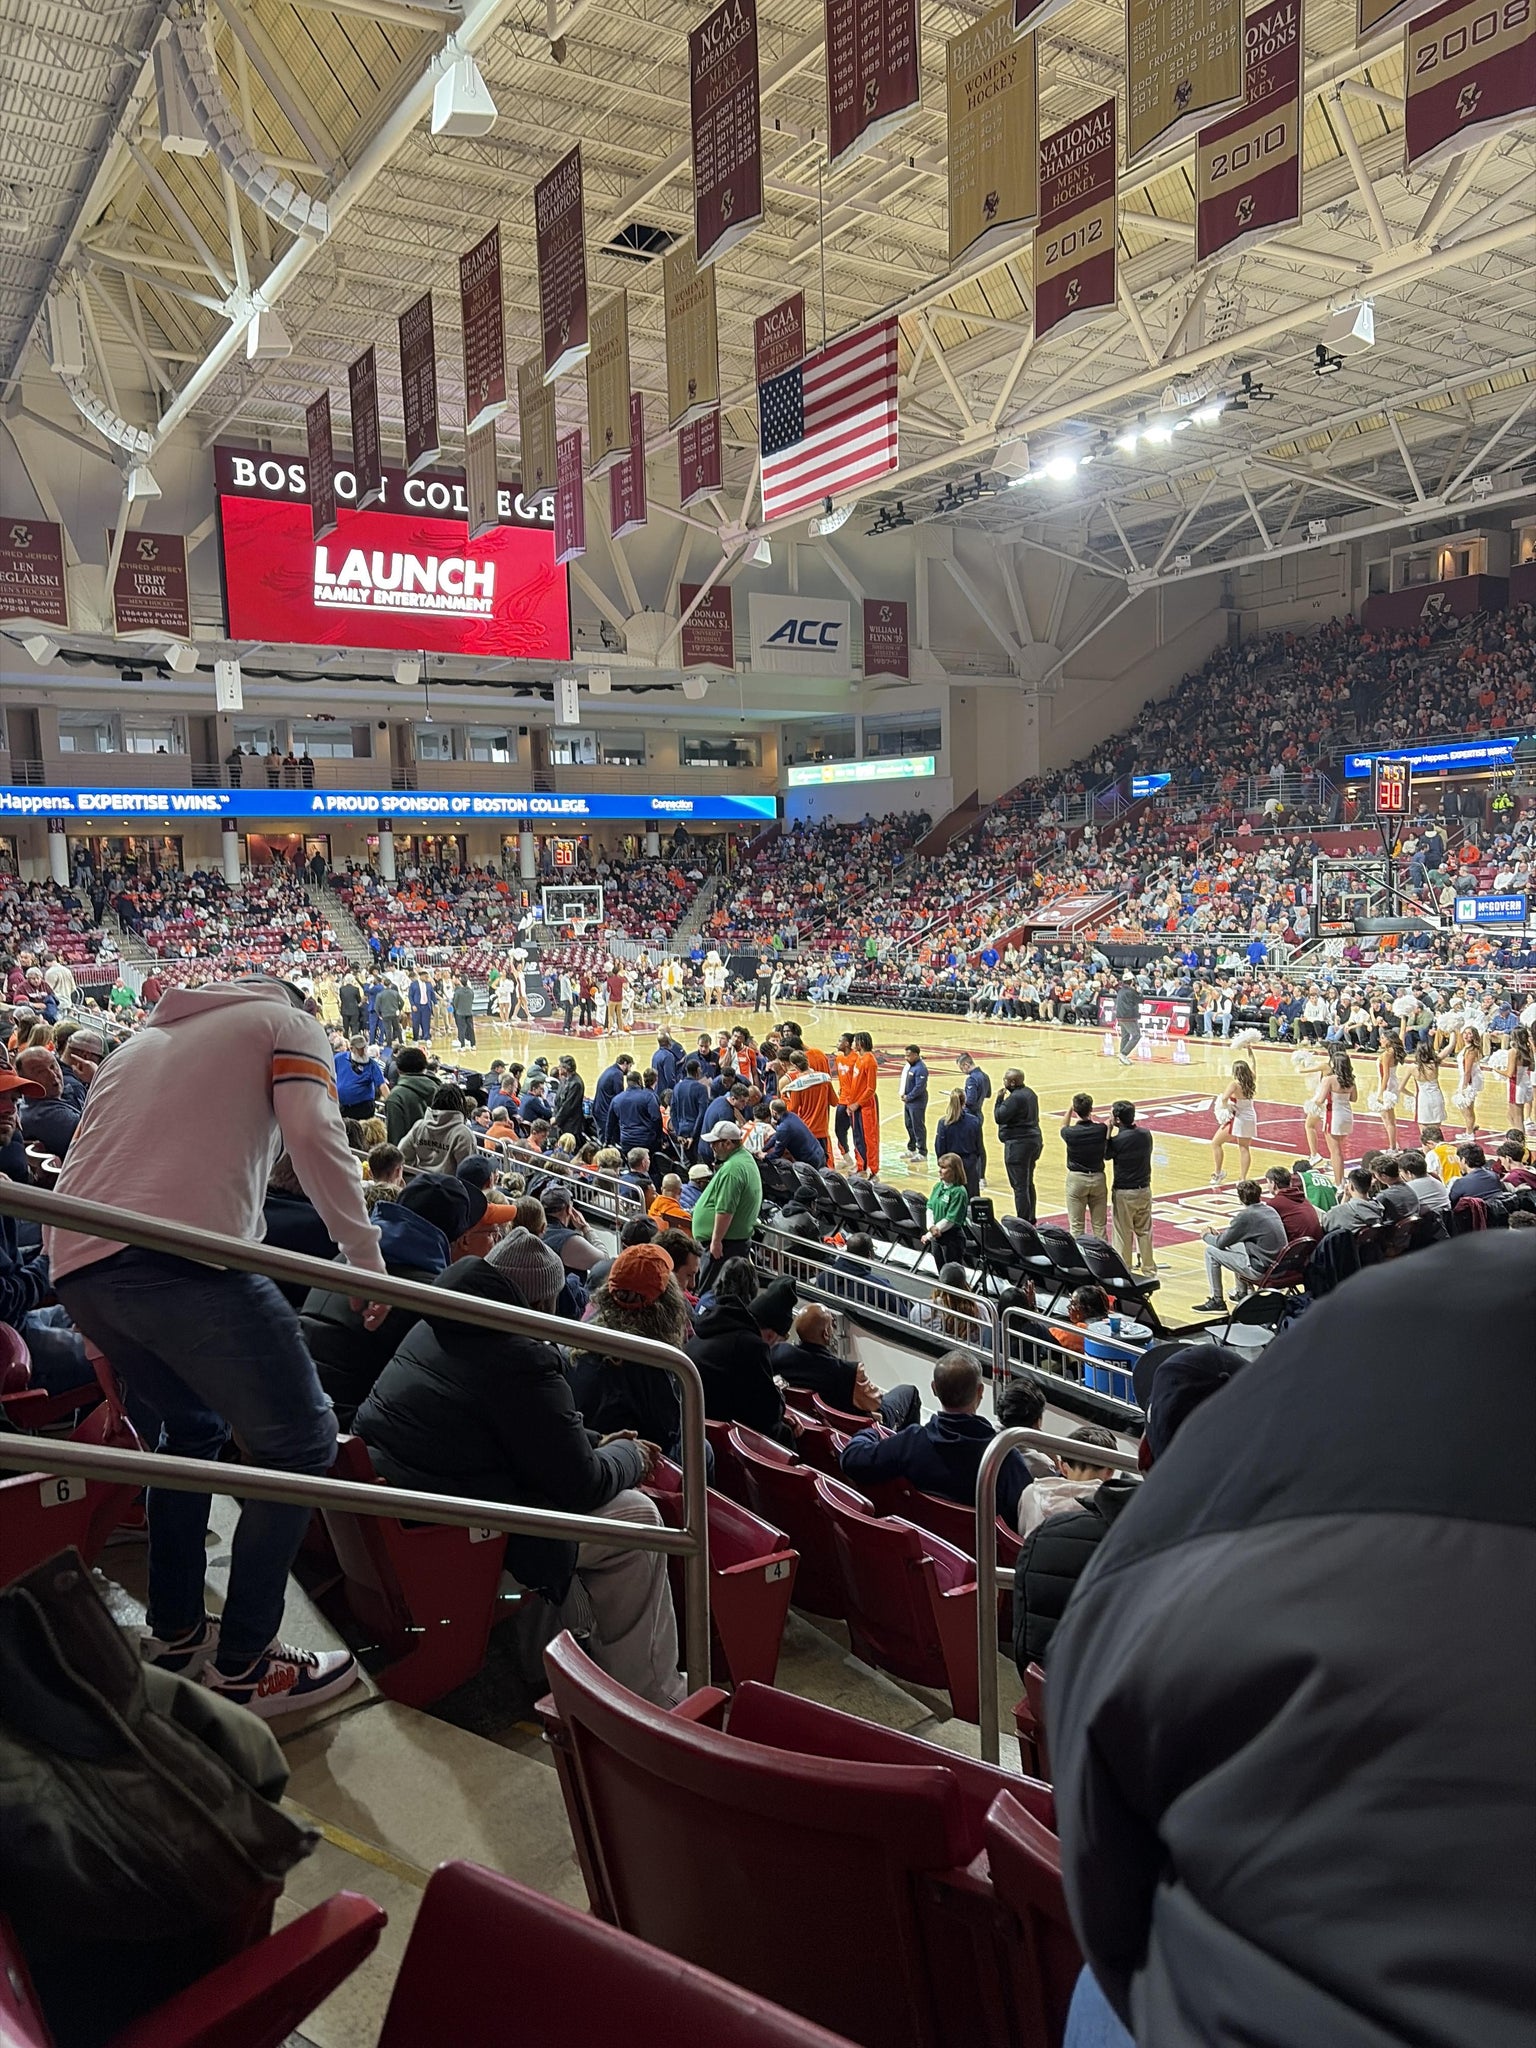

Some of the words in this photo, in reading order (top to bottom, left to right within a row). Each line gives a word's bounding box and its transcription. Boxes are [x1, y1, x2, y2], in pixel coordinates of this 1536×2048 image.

[833, 0, 853, 19] 1948
[860, 10, 880, 31] 1973
[701, 0, 742, 57] NCAA
[833, 15, 853, 35] 1949
[861, 25, 880, 47] 1978
[888, 20, 907, 41] 1991
[1208, 25, 1236, 48] 2016
[1245, 3, 1297, 49] ONAL
[696, 16, 750, 77] APPEARANCES
[833, 31, 853, 50] 1950
[888, 35, 909, 58] 1998
[1149, 39, 1187, 70] FROZEN
[1189, 20, 1217, 45] FOUR
[1208, 36, 1236, 61] 2017
[1245, 23, 1297, 67] PIONS
[1416, 0, 1531, 75] 2008
[834, 47, 853, 66] 1954
[861, 42, 880, 63] 1984
[888, 52, 909, 75] 1999
[955, 33, 1012, 81] CHAMPIO
[1169, 48, 1197, 71] 2013
[709, 51, 737, 87] MEN'S
[834, 63, 853, 82] 1956
[861, 59, 880, 79] 1985
[964, 51, 1018, 95] WOMEN'S
[1169, 60, 1197, 83] 2015
[1248, 63, 1268, 87] N'S
[706, 65, 741, 107] HOCKEY
[834, 79, 854, 98] 1959
[968, 69, 1015, 111] HOCKEY
[1133, 72, 1158, 95] 2007
[1133, 84, 1158, 106] 2011
[1248, 76, 1276, 103] KEY
[835, 95, 854, 114] 1963
[1040, 110, 1112, 166] NATIONAL
[1040, 128, 1112, 182] CHAMPIONS
[1210, 123, 1286, 181] 2010
[1057, 161, 1090, 190] MEN'S
[1053, 173, 1096, 208] HOCKEY
[539, 184, 580, 231] CHAMPIONS
[1045, 218, 1103, 266] 2012
[462, 232, 498, 280] BEANPOT
[673, 249, 698, 276] NCA
[463, 254, 498, 291] CHAMPIONS
[675, 277, 705, 304] WOMEN'S
[671, 285, 709, 320] BASKETBALL
[764, 306, 795, 337] NCAA
[761, 320, 799, 350] APPEARANCES
[761, 345, 799, 373] BASKETBALL
[770, 339, 789, 358] MEN'S
[557, 437, 575, 459] ELITE
[404, 479, 555, 521] COLEGE
[13, 560, 34, 573] LEN
[119, 562, 150, 571] ETIRED
[315, 545, 495, 597] LAUNCH
[0, 570, 59, 587] EGLARSKI
[133, 573, 167, 587] JERRY
[135, 584, 168, 597] YORK
[314, 585, 371, 603] FAMILY
[373, 589, 493, 612] ENTERTAINMENT
[31, 600, 60, 608] PLAYER
[33, 607, 61, 615] COACH
[694, 610, 727, 619] DONALD
[155, 612, 184, 620] PLAYER
[161, 619, 188, 627] COACH
[767, 619, 844, 647] ACC
[869, 625, 898, 634] WILLIAM
[869, 633, 893, 643] FLYNN
[0, 793, 75, 813] Happens.
[77, 793, 168, 810] EXPERTISE
[313, 796, 324, 810] A
[327, 796, 379, 811] PROUD
[382, 797, 449, 812] SPONSOR
[451, 798, 470, 812] OF
[473, 799, 527, 813] BOSTON
[530, 799, 589, 814] COLLEGE.
[652, 798, 693, 810] Connection
[1380, 782, 1402, 808] 30
[556, 850, 573, 864] 30
[1463, 903, 1471, 916] M
[56, 1479, 70, 1502] 6
[479, 1526, 491, 1540] 5
[774, 1563, 782, 1579] 4
